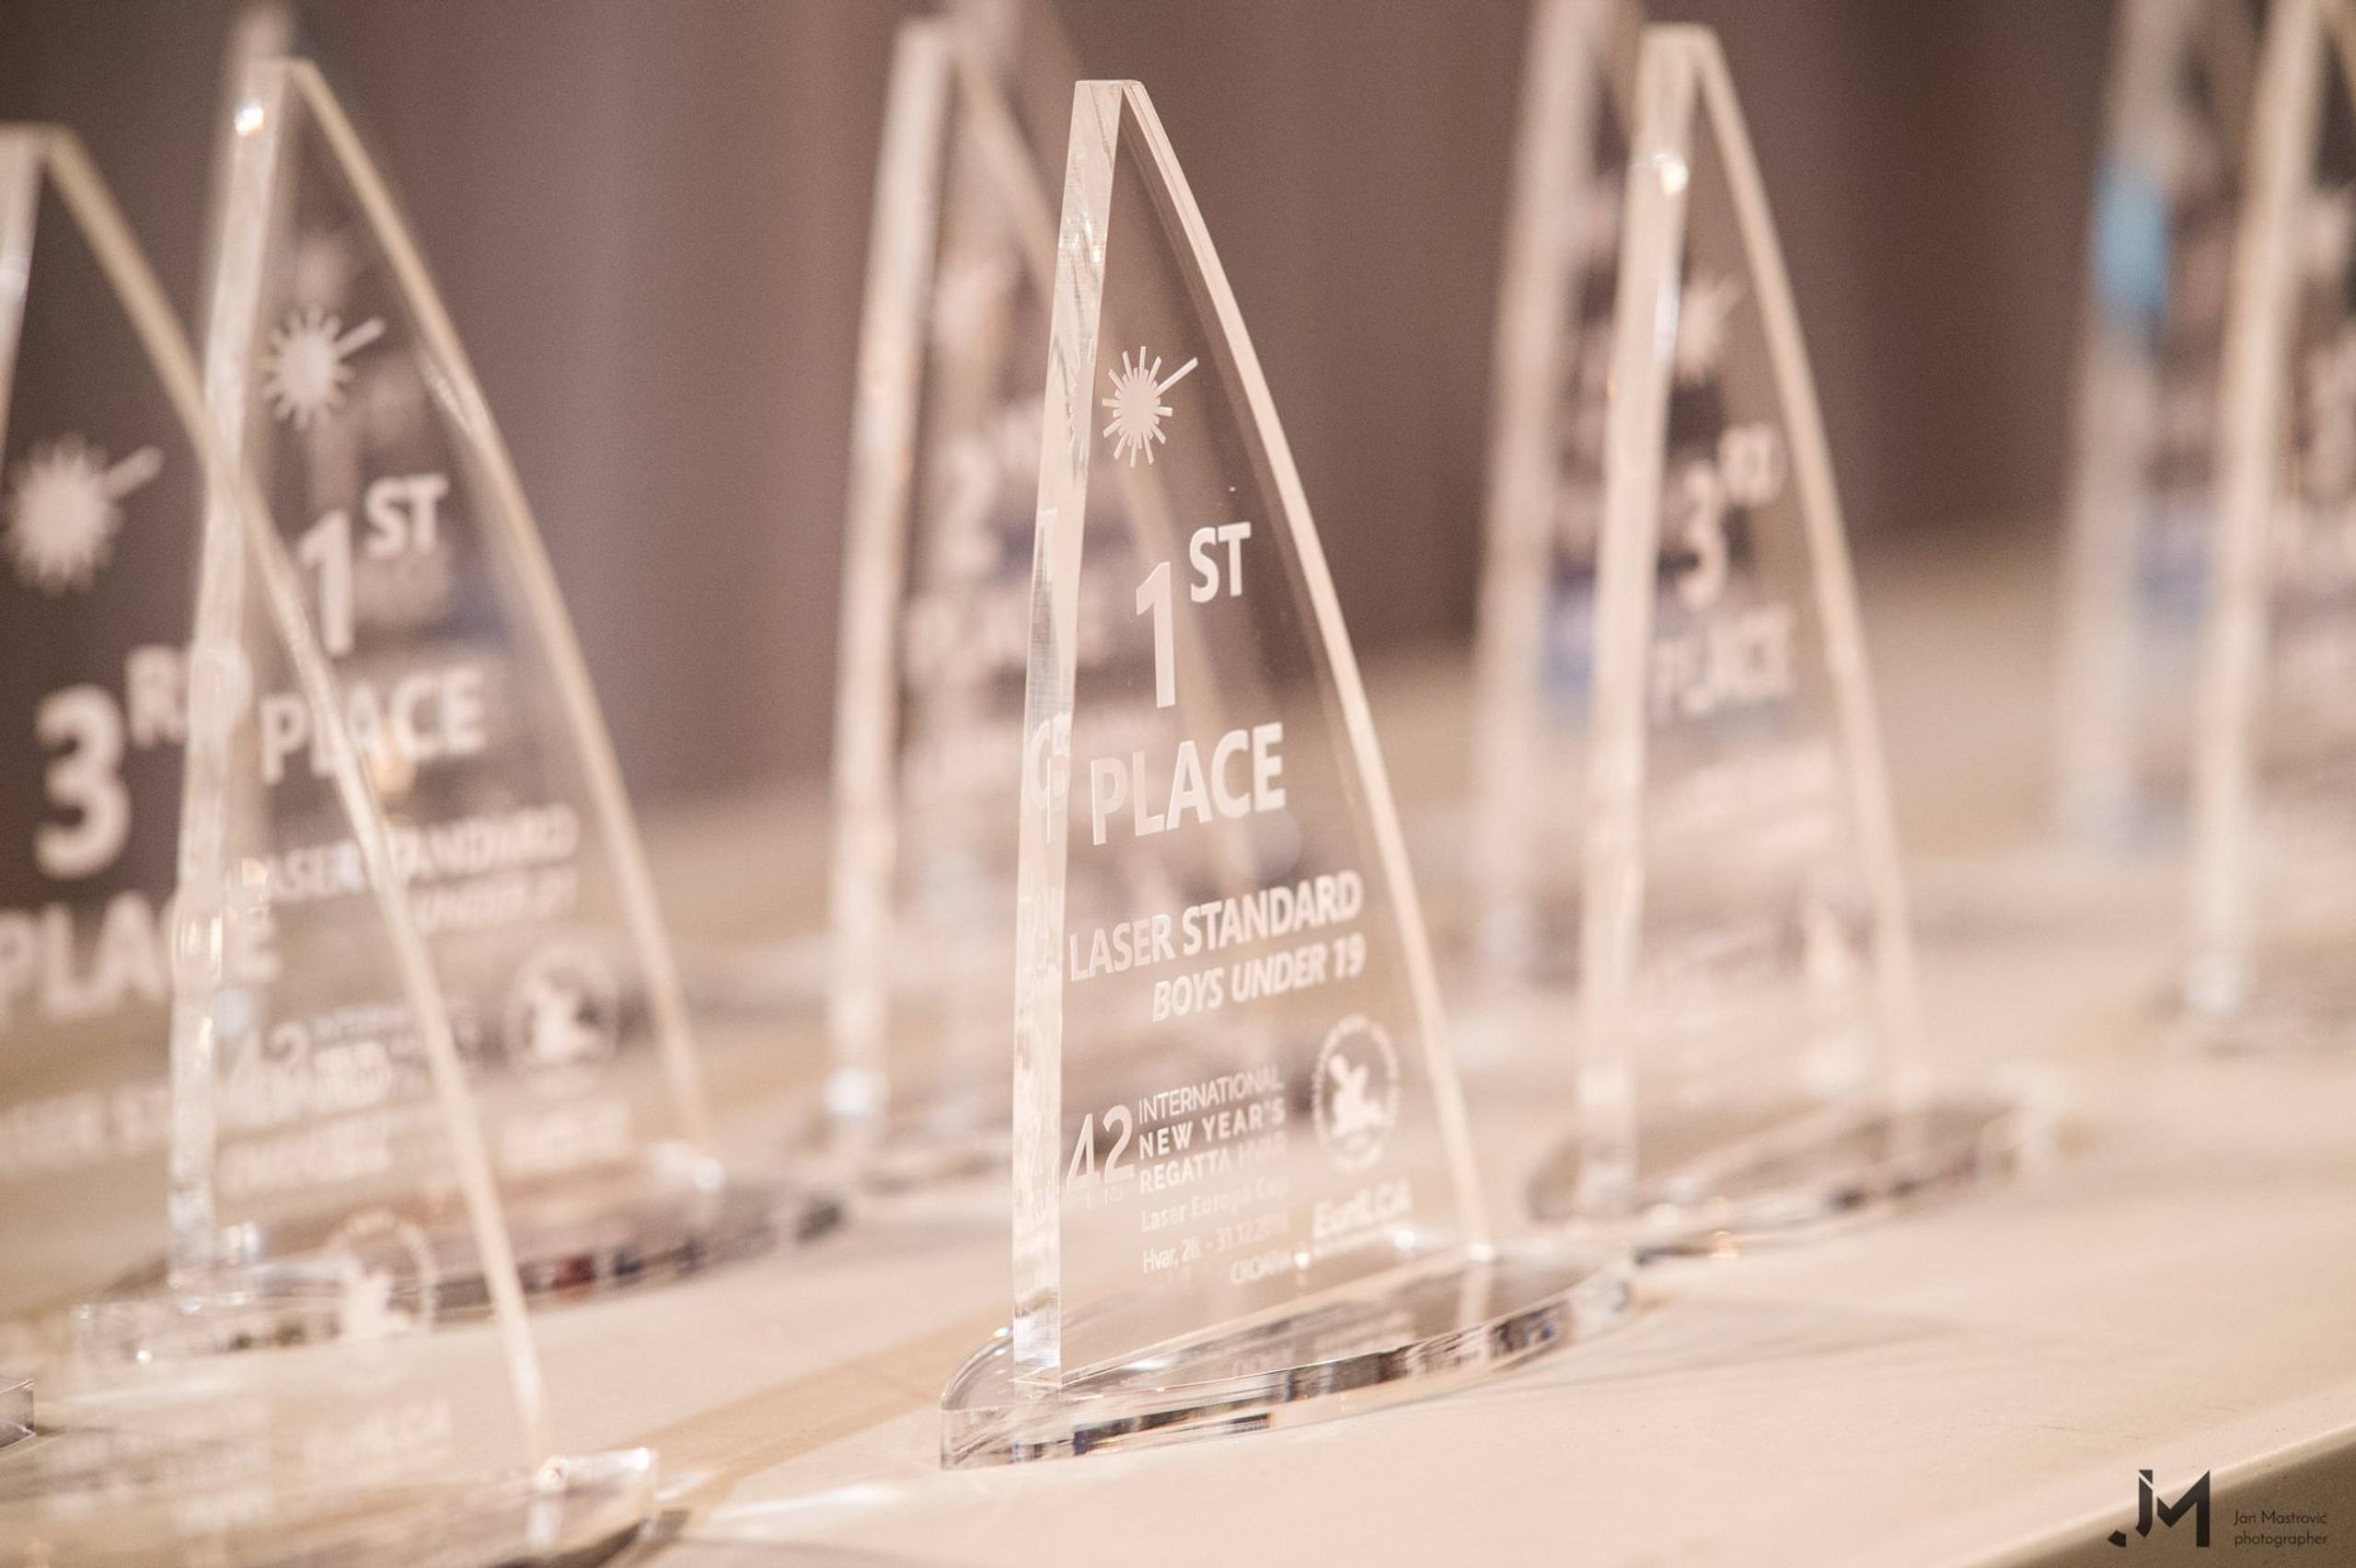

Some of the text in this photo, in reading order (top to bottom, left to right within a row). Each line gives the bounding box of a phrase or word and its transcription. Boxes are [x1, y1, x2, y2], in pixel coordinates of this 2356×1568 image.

[298, 473, 447, 655] 1ST
[1136, 522, 1252, 708] 1ST
[1091, 722, 1286, 846] PLACE
[1069, 869, 1364, 983] LASER STANDARD
[1151, 931, 1368, 1023] BOYS UNDER 19
[1138, 1061, 1285, 1125] INTERNATIONAL
[1138, 1096, 1287, 1160] NEW YEAR'S
[1066, 1104, 1135, 1195] 42
[1139, 1147, 1232, 1195] REGATTA
[1140, 1205, 1187, 1233] Laser
[1141, 1246, 1180, 1274] Hvar,
